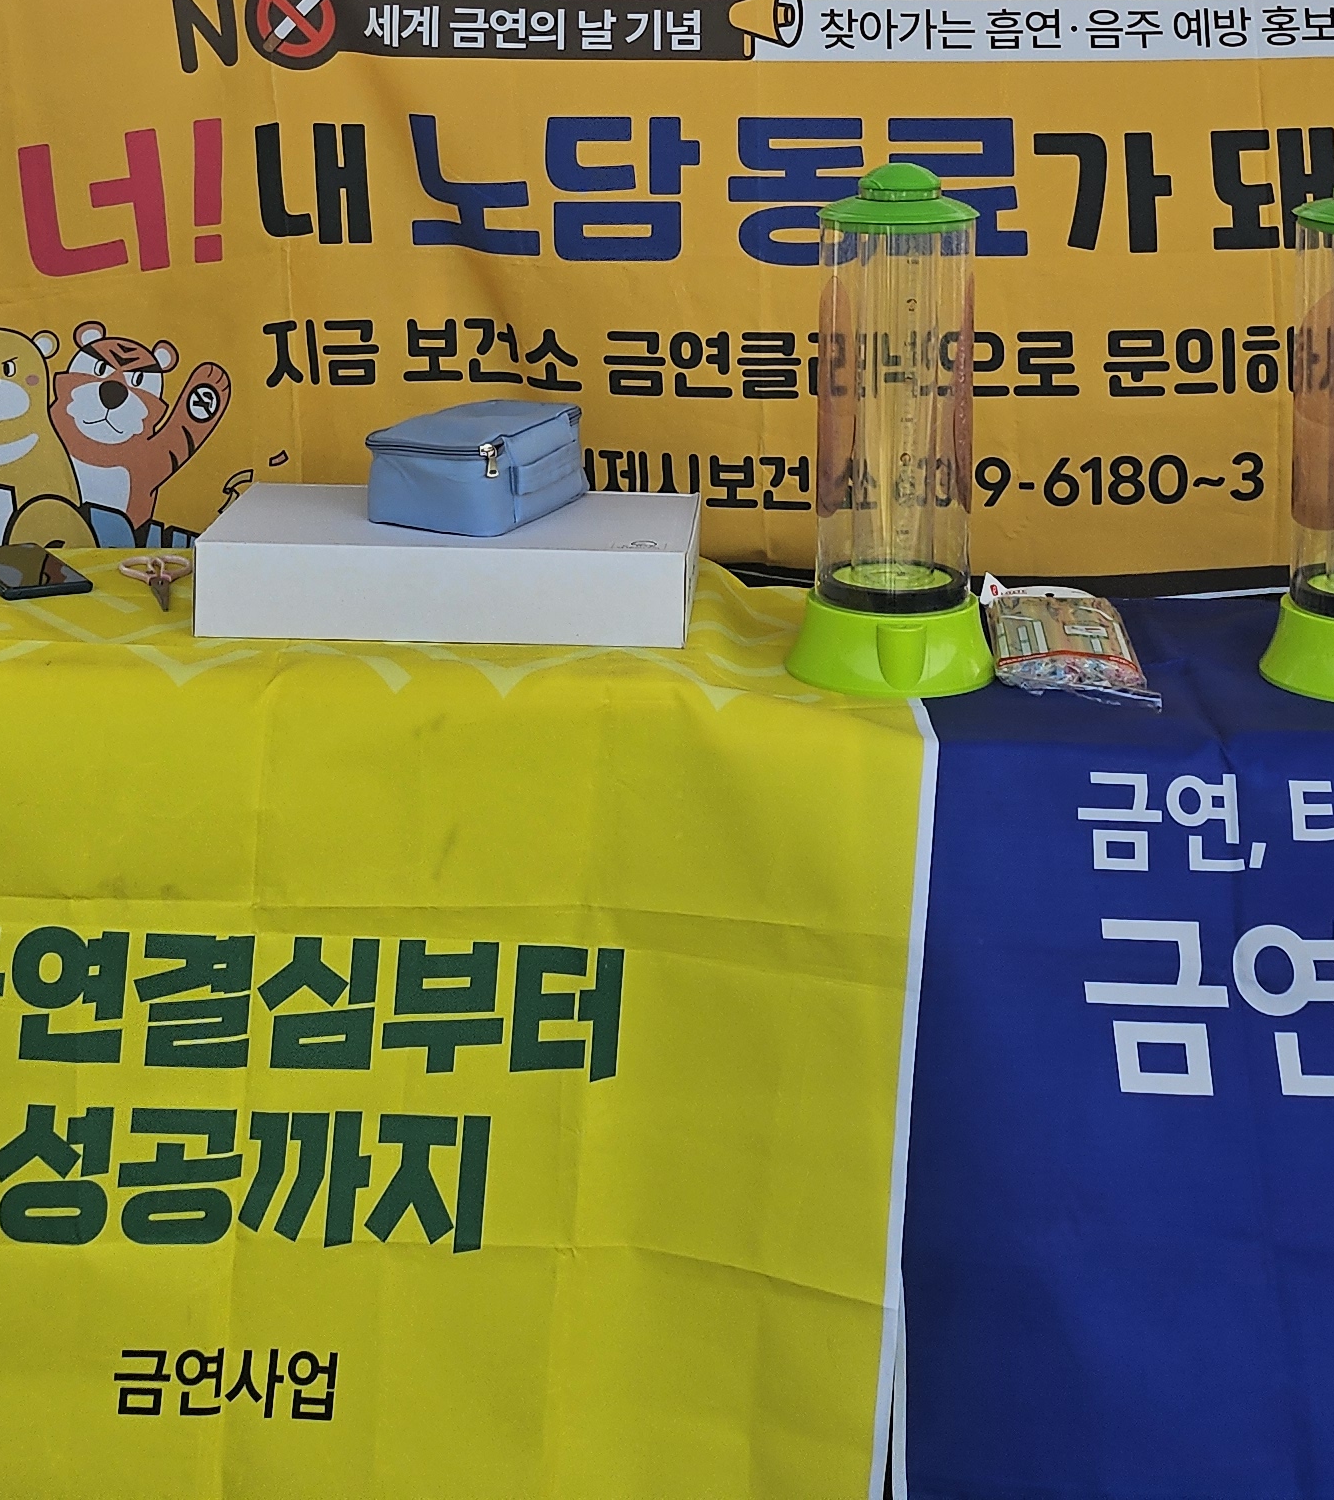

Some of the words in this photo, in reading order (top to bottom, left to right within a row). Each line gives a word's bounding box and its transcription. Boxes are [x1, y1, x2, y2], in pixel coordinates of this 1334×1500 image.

[364, 5, 439, 49] 세계
[449, 8, 565, 51] 금연의
[578, 9, 617, 51] 날
[625, 9, 703, 51] 기념
[819, 8, 976, 51] 찾아가는
[1173, 6, 1252, 49] 예방
[18, 118, 223, 277] 너!
[254, 121, 372, 244] 내
[408, 113, 700, 261] 노담
[262, 318, 379, 388] 지금
[403, 317, 583, 392] 보건소
[1076, 770, 1266, 873] 금연,
[114, 1346, 340, 1422] 금연사업
